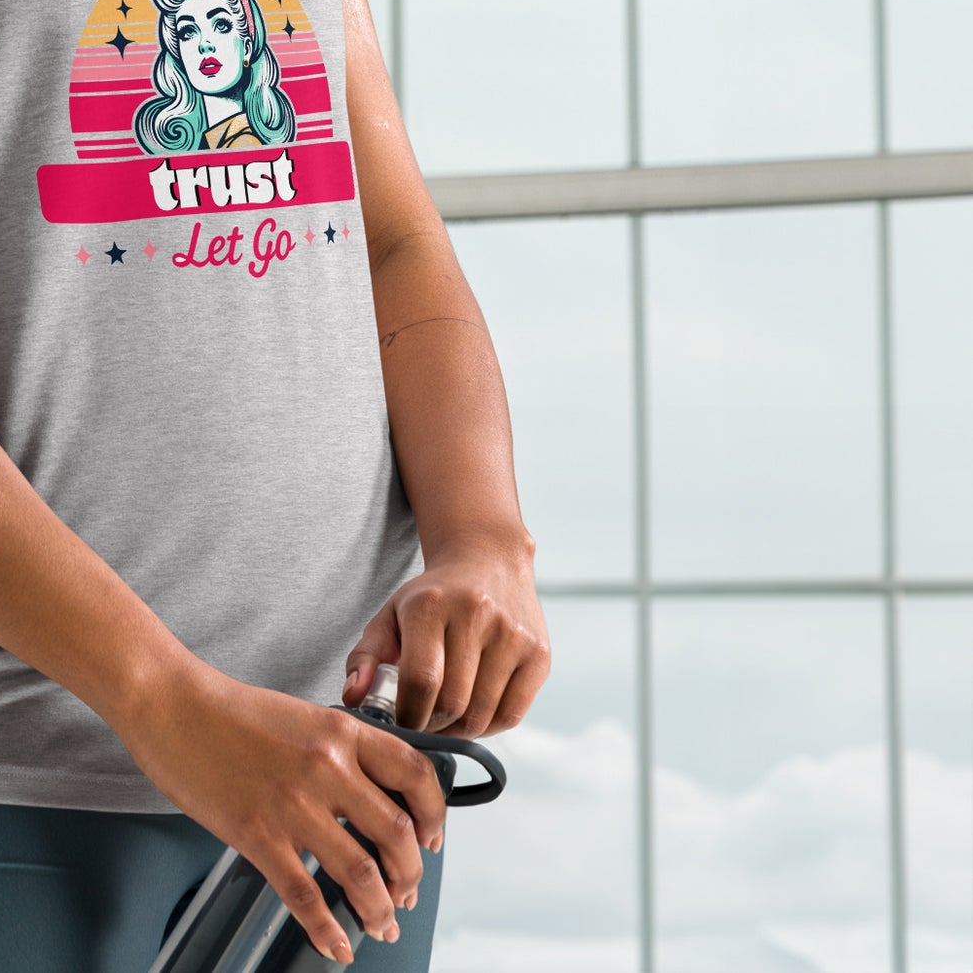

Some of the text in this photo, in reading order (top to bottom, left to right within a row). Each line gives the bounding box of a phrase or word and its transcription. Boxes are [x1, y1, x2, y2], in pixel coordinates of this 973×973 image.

[149, 149, 298, 211] trust
[172, 218, 296, 278] Let Go
